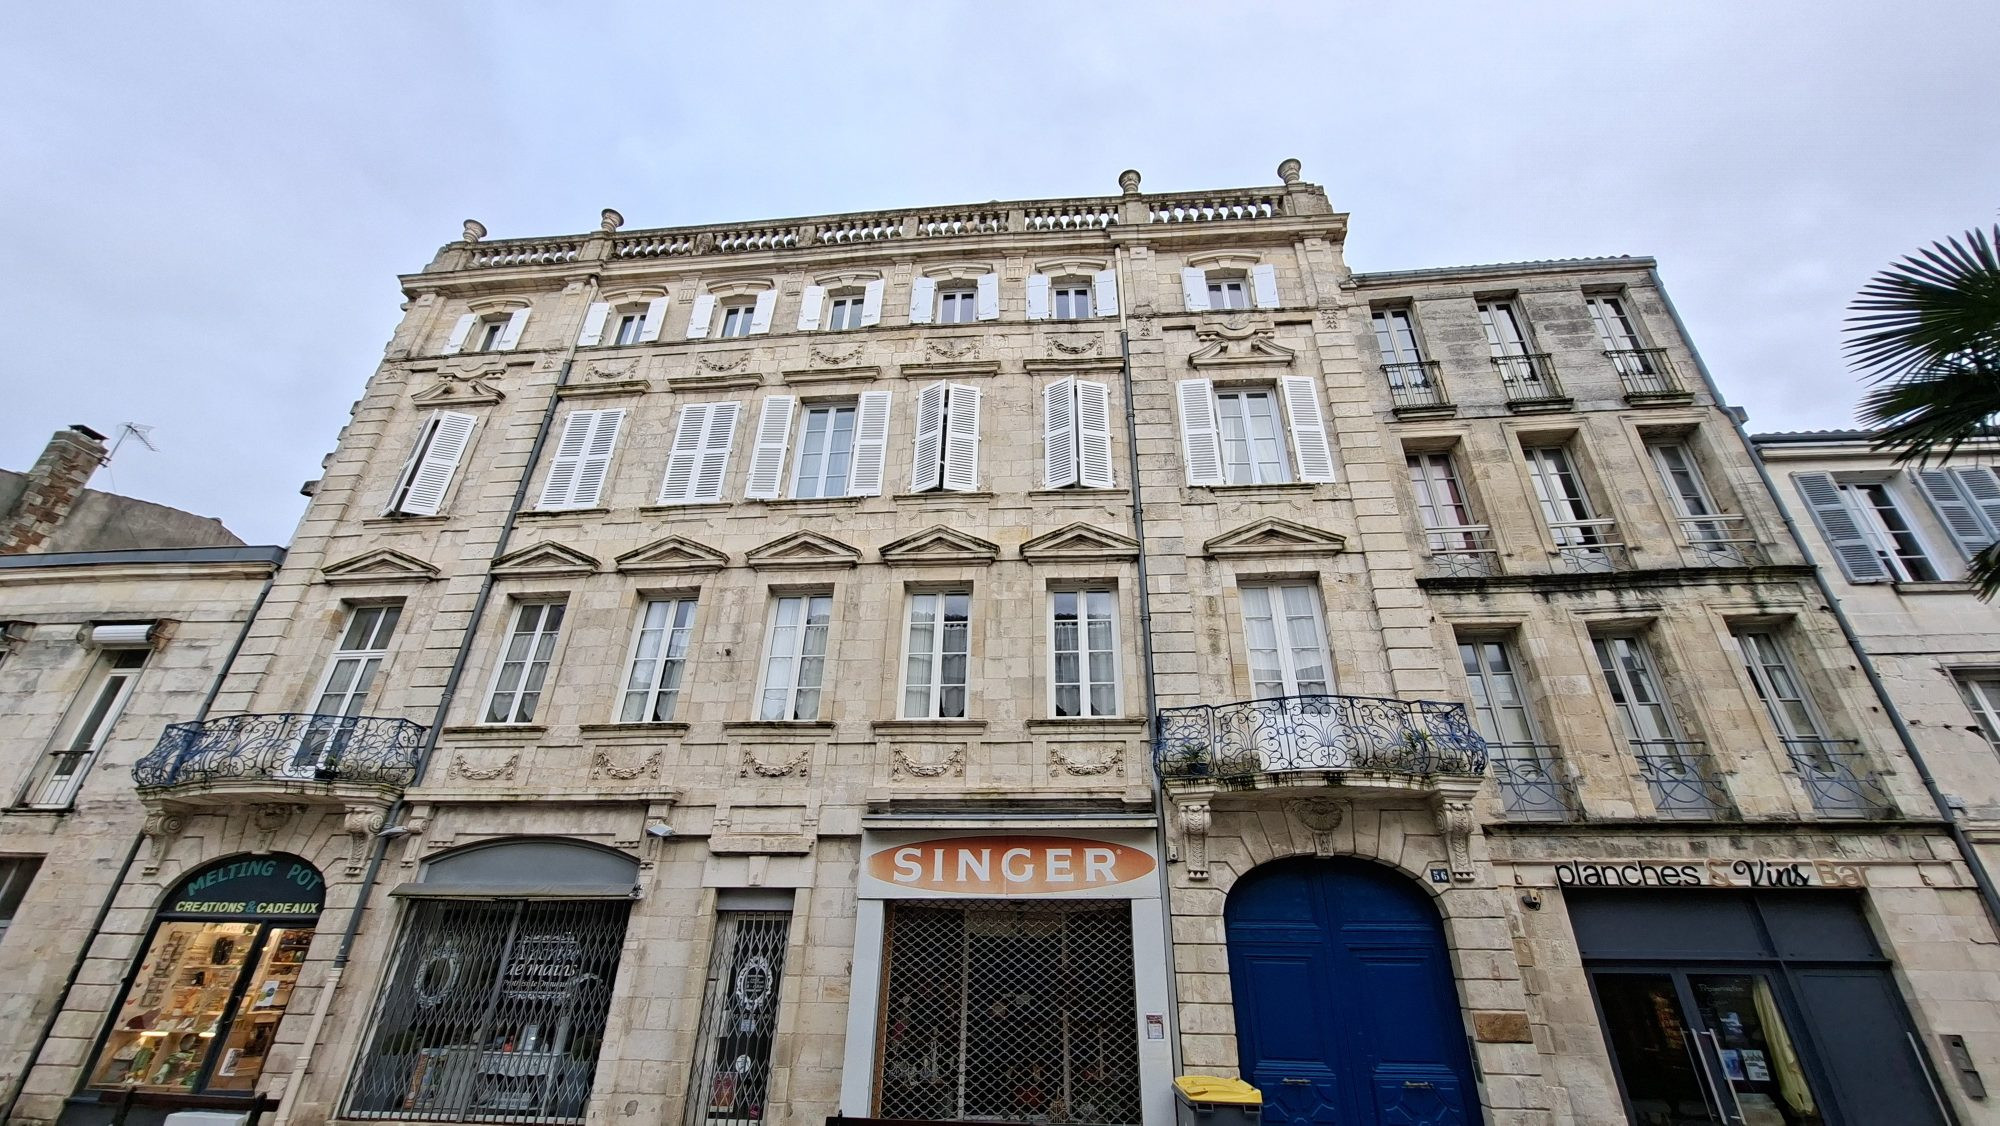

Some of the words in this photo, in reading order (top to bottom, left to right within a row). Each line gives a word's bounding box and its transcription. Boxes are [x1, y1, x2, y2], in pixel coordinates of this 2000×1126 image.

[187, 860, 277, 896] MELTING
[286, 863, 321, 891] POT
[893, 848, 1118, 883] SINGER
[1432, 870, 1448, 881] 56
[1554, 859, 1701, 887] planches
[1704, 858, 1736, 887] &
[1731, 859, 1810, 887] Vins
[1811, 859, 1872, 887] Bar
[175, 901, 247, 913] CREATIONS
[256, 902, 319, 914] CADEAUX
